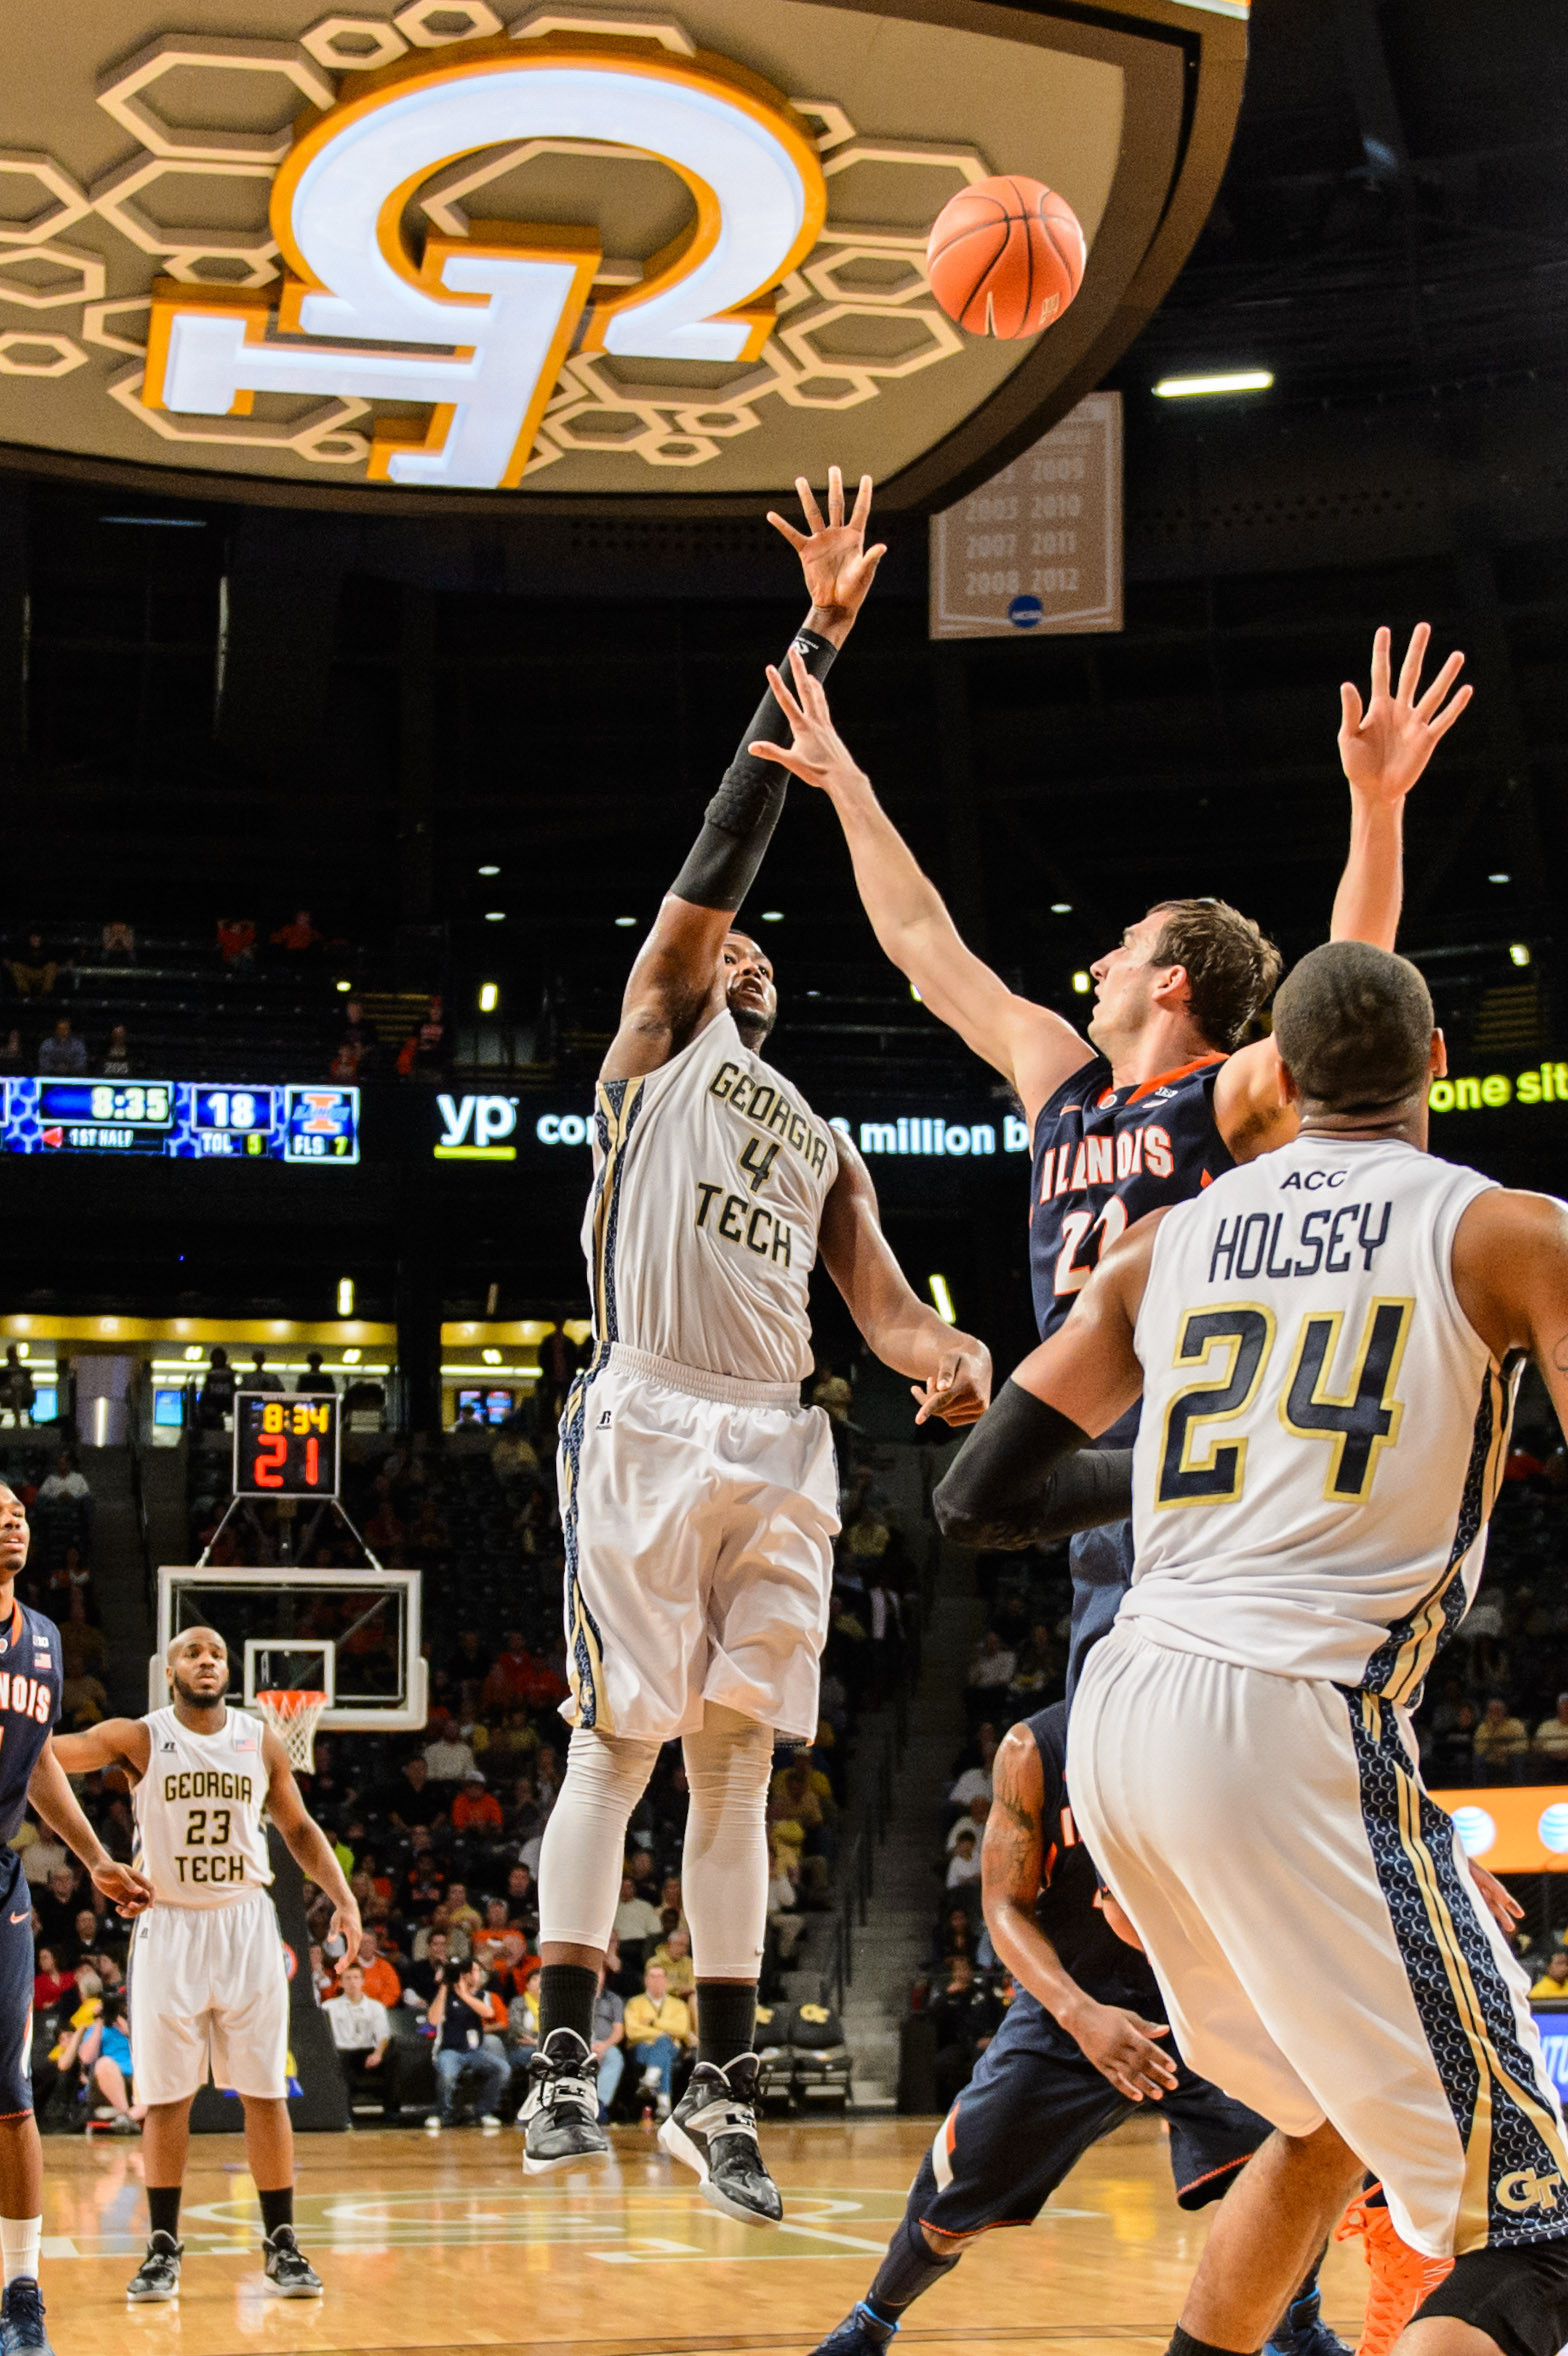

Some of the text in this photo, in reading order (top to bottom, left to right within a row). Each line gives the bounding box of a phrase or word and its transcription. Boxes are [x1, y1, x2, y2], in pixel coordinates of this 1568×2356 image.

[1031, 530, 1077, 556] 2011
[1031, 567, 1080, 593] 2012
[91, 1086, 169, 1121] 8:35
[207, 1093, 256, 1128] 18
[1428, 1074, 1512, 1113] one
[70, 1128, 134, 1148] 1ST HALF
[436, 1094, 518, 1147] yp
[709, 1061, 829, 1180] GEORGIA
[860, 1117, 996, 1155] million
[201, 1132, 233, 1154] TOL
[293, 1134, 348, 1156] FLS 7
[739, 1137, 781, 1194] 4
[1040, 1124, 1175, 1206] ILLNOIS
[1279, 1170, 1348, 1191] ACC
[697, 1181, 793, 1270] TECH
[1208, 1201, 1393, 1284] HOLSEY
[262, 1402, 330, 1436] 8:34
[1154, 1296, 1417, 1512] 24
[253, 1433, 319, 1488] 21
[163, 1771, 253, 1804] GEORGIA
[186, 1809, 232, 1846] 23
[174, 1855, 245, 1883] TECH
[1495, 2166, 1562, 2212] GT
